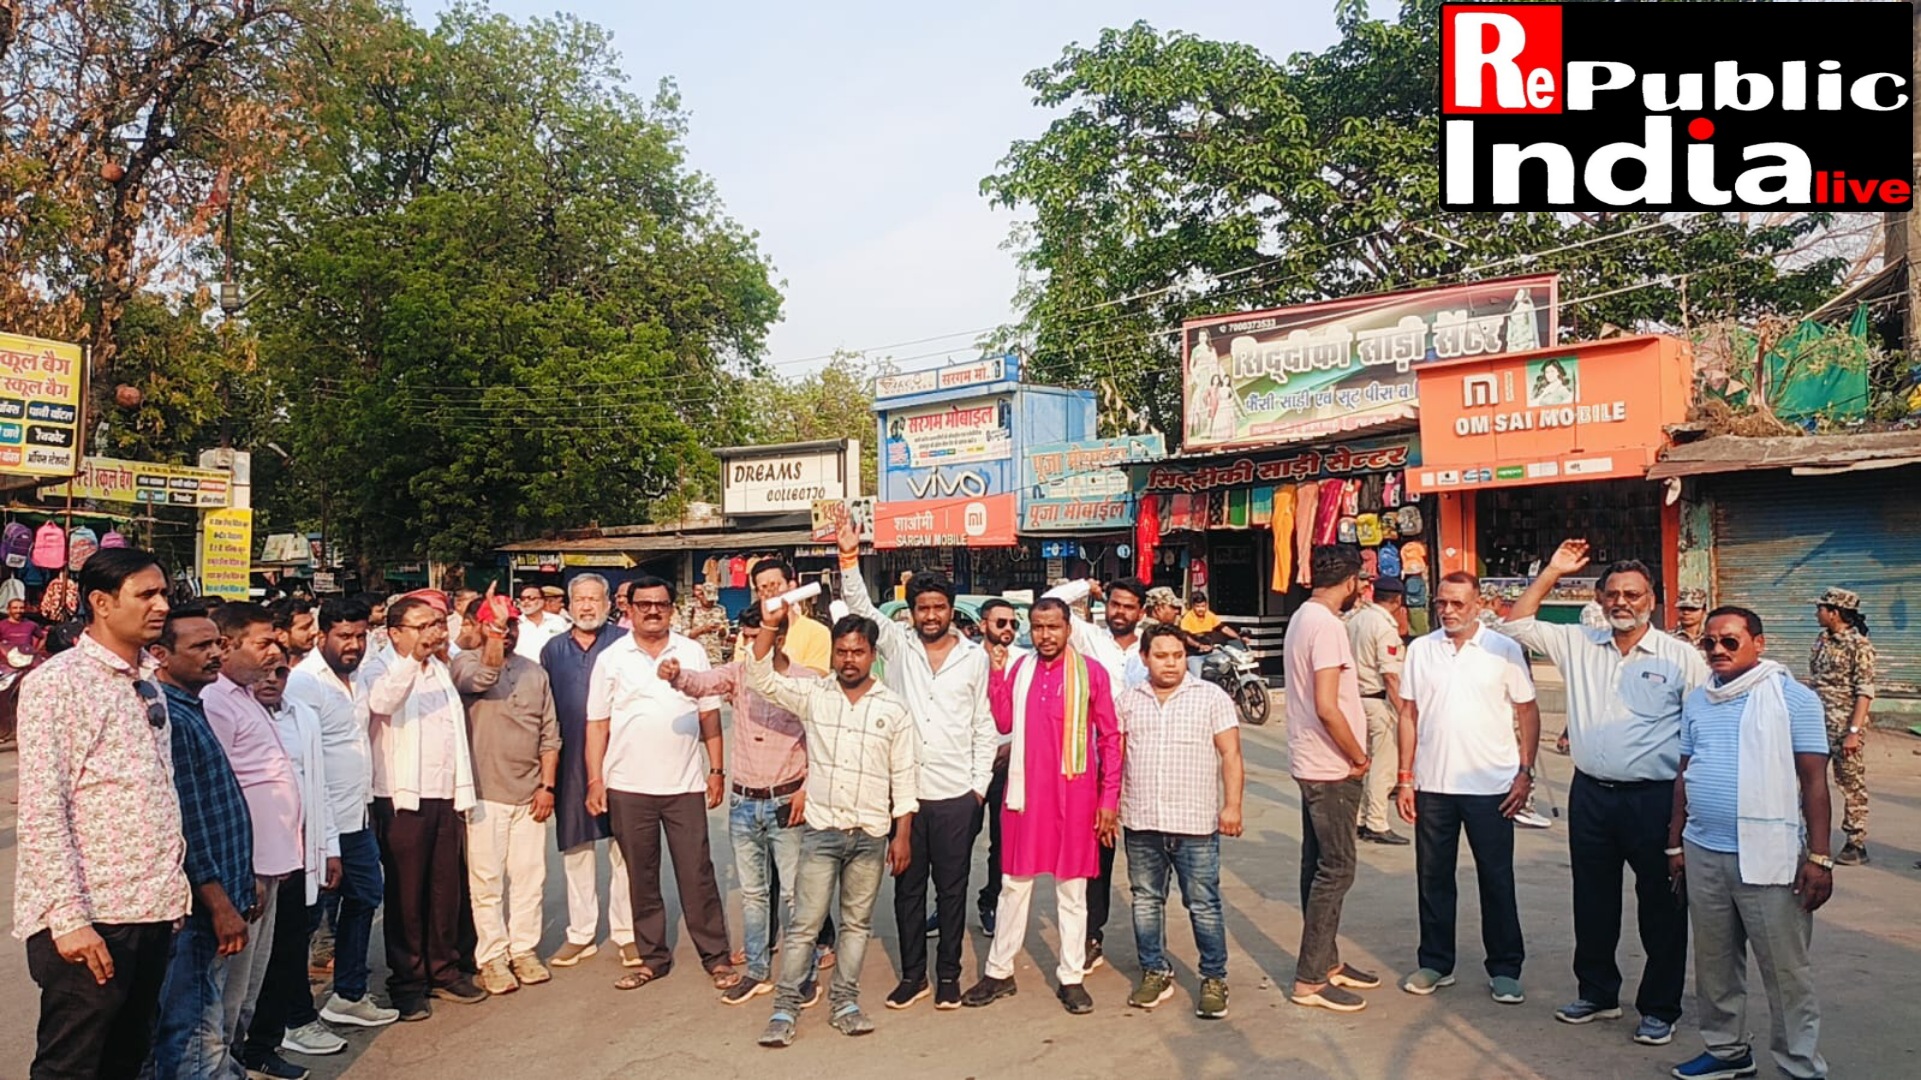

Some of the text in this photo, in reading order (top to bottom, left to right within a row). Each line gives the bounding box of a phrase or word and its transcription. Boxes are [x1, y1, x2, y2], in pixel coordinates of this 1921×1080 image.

[1355, 315, 1429, 373] साड़ी
[41, 349, 71, 376] बैग
[4, 377, 70, 398] स्कूल बैग
[941, 370, 971, 386] सरगम
[1338, 387, 1361, 410] सूट
[1364, 381, 1395, 402] पीस
[907, 403, 994, 433] सरगम मोबाइल
[1455, 401, 1626, 436] OM SAI MOBILE
[734, 461, 803, 483] DREAMS
[1031, 452, 1064, 484] पूजा
[1147, 458, 1255, 493] सिद्दीकी
[1257, 451, 1322, 481] साड़ी
[1324, 445, 1409, 473] सेन्टर
[1029, 504, 1061, 528] पूजा
[895, 532, 969, 548] SARGAM MOBILE
